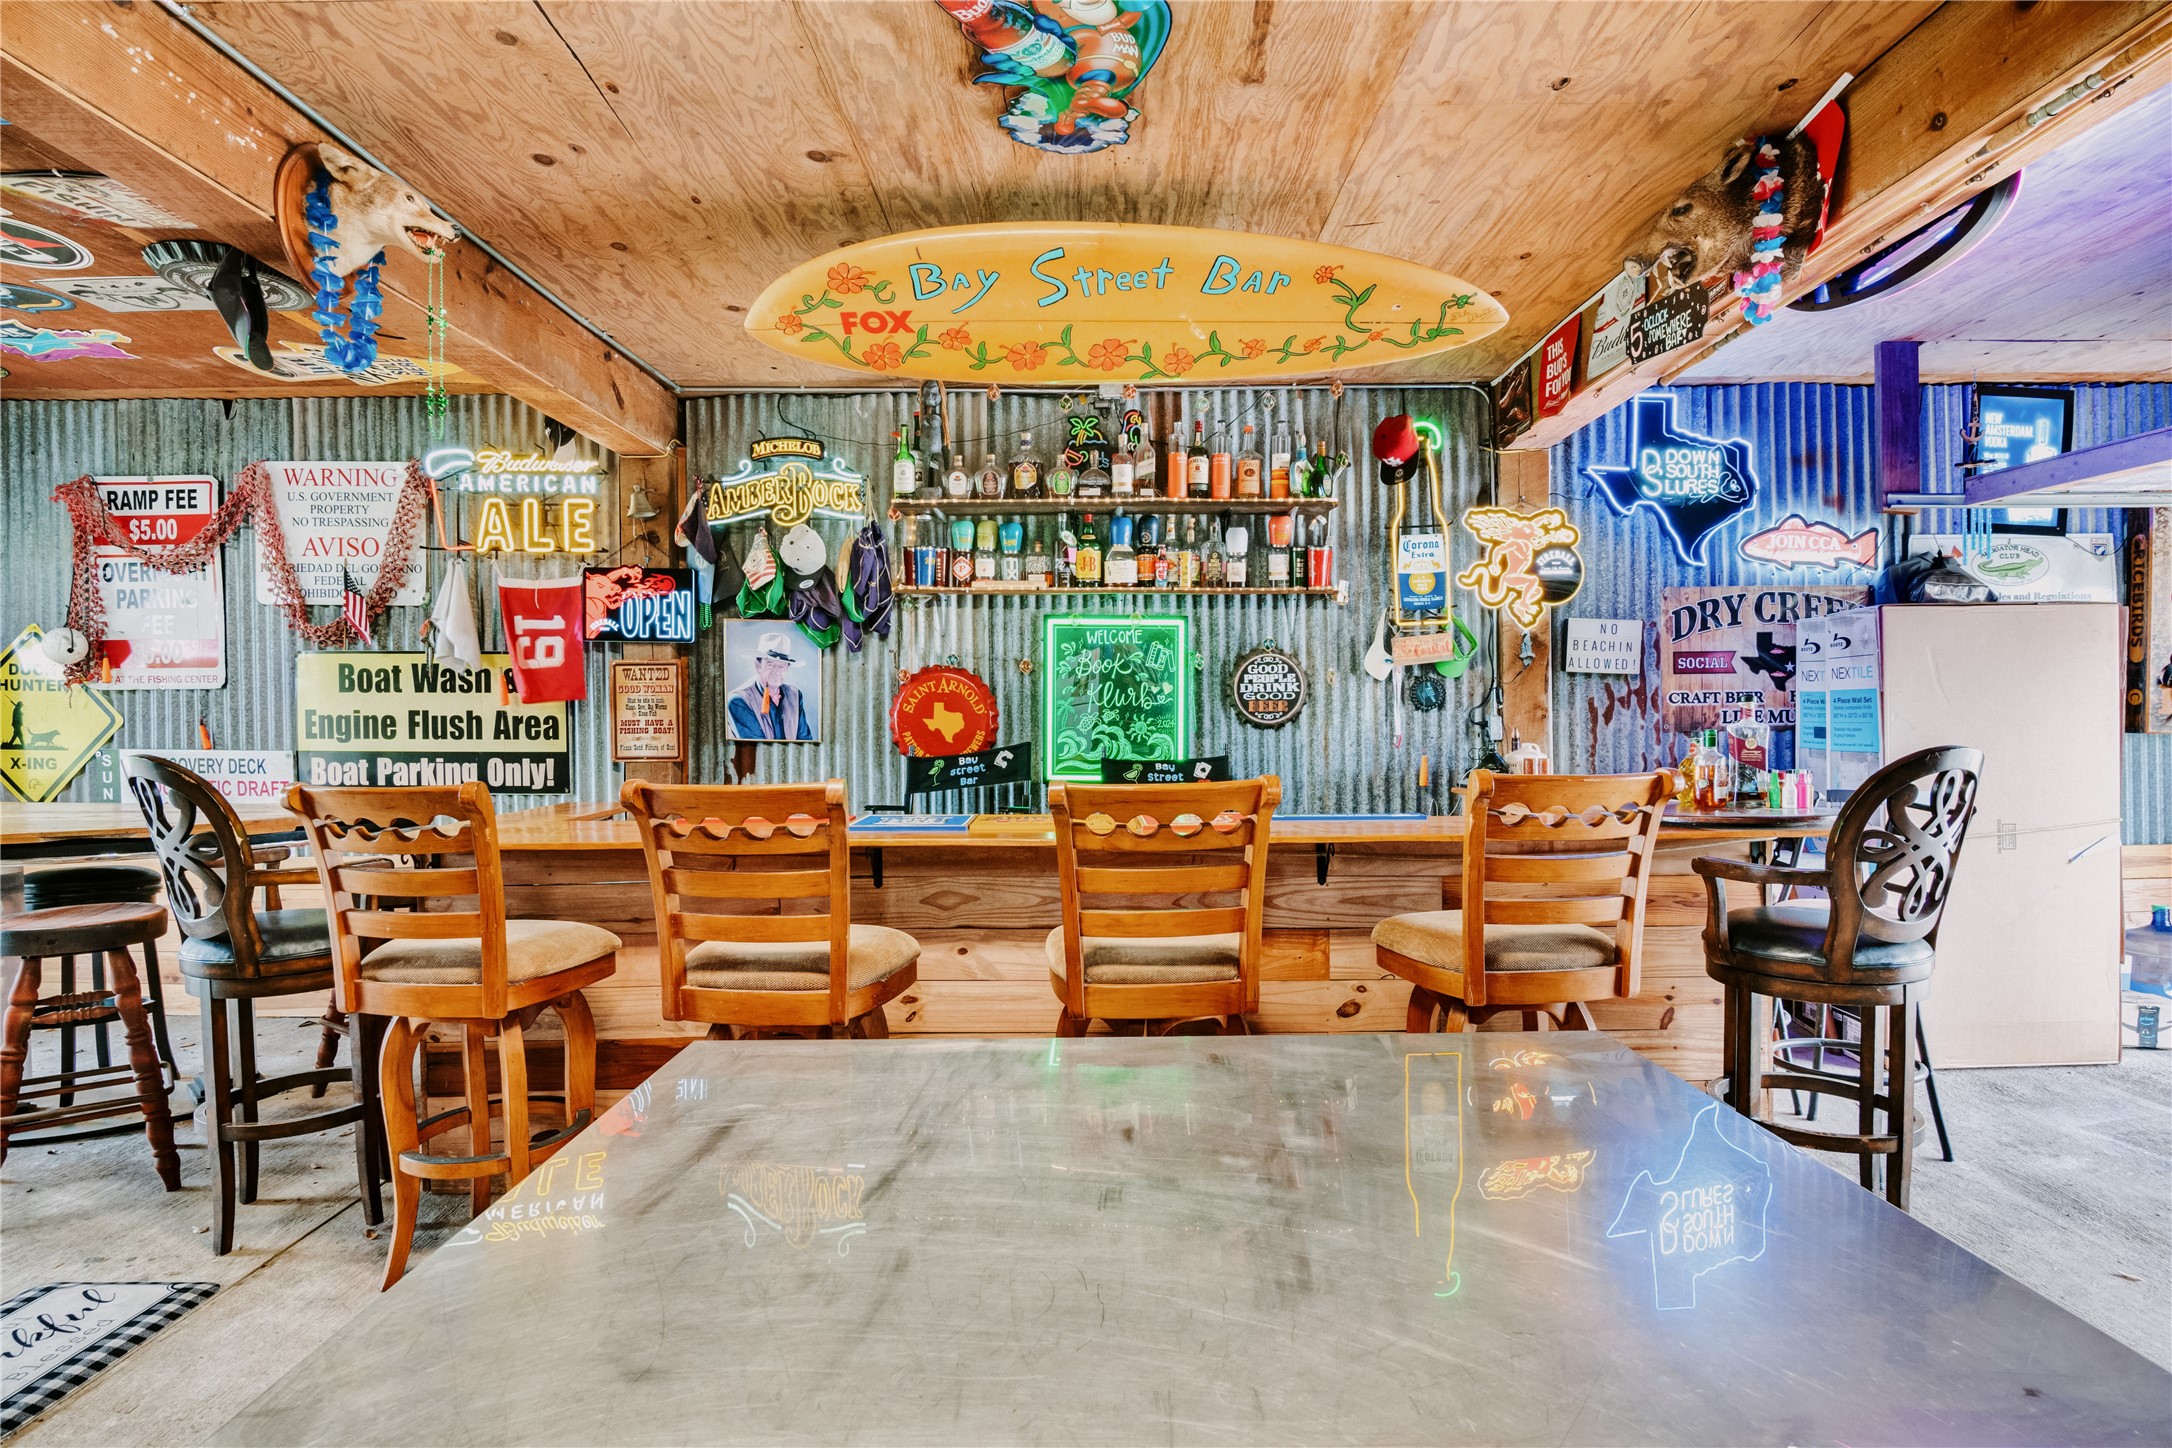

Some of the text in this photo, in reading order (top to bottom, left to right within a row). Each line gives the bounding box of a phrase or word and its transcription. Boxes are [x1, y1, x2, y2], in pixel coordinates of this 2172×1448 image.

[1110, 32, 1135, 44] BUD
[1112, 43, 1138, 58] MAN
[1030, 247, 1174, 308] Street
[839, 310, 916, 335] FOX
[1648, 309, 1692, 341] SOMEWHERE
[1630, 321, 1643, 358] 5
[1547, 337, 1563, 361] THIS
[1986, 412, 2003, 424] NEW
[1985, 425, 2033, 438] AMSTERDAM
[752, 442, 822, 457] MICHELOB
[1665, 449, 1720, 463] DOWN
[477, 451, 598, 473] Budweiser
[284, 468, 399, 487] WARNING
[1666, 464, 1720, 479] SOUTH
[459, 474, 597, 493] AMERICAN
[1666, 479, 1720, 494] LURES
[107, 489, 198, 511] RAMP FEE
[287, 492, 394, 502] U.S. GOVERNMENT
[310, 505, 370, 515] PROPERTY
[292, 517, 389, 528] NO TRESPASSING
[476, 497, 595, 553] ALE
[129, 518, 178, 543] $5.00
[302, 537, 380, 558] AVISO
[1403, 540, 1439, 552] Corona
[1767, 535, 1842, 550] JOIN CCA
[2021, 547, 2040, 558] HEAD
[314, 576, 367, 586] FEDEAL
[2014, 591, 2092, 601] and Regulations
[620, 591, 691, 638] OPEN
[1672, 593, 1747, 643] DRY
[1600, 623, 1618, 635] NO
[1087, 629, 1142, 645] WELCOME
[1573, 640, 1633, 653] BEACHIN
[1076, 649, 1133, 678] Book
[1248, 664, 1288, 674] GOOD
[1678, 657, 1728, 669] SOCIAL
[148, 675, 183, 684] FISHING
[185, 675, 218, 684] CENTER
[338, 663, 402, 694] Boat
[411, 663, 492, 694] Wash
[622, 668, 669, 681] WANTED
[1244, 674, 1296, 683] PEOPLE
[1831, 665, 1873, 680] NEXTILE
[618, 685, 674, 693] GOOD WOMAN
[1240, 683, 1300, 693] DRINK
[902, 677, 986, 714] SAINT ARNOLD
[1243, 691, 1296, 700] GOOD
[1669, 692, 1721, 704] CRAFT
[1249, 700, 1289, 712] BEER
[305, 710, 560, 743] Engine Flush Area
[1158, 719, 1176, 728] 2024
[10, 757, 57, 770] X-ING
[228, 758, 266, 774] DECK
[958, 757, 978, 766] Bay
[1155, 763, 1175, 773] Bay
[102, 754, 114, 800] SUN
[311, 757, 555, 790] Boat Parking Only!
[1147, 771, 1184, 782] Street
[960, 777, 978, 785] Bar
[237, 781, 289, 796] DRAFT
